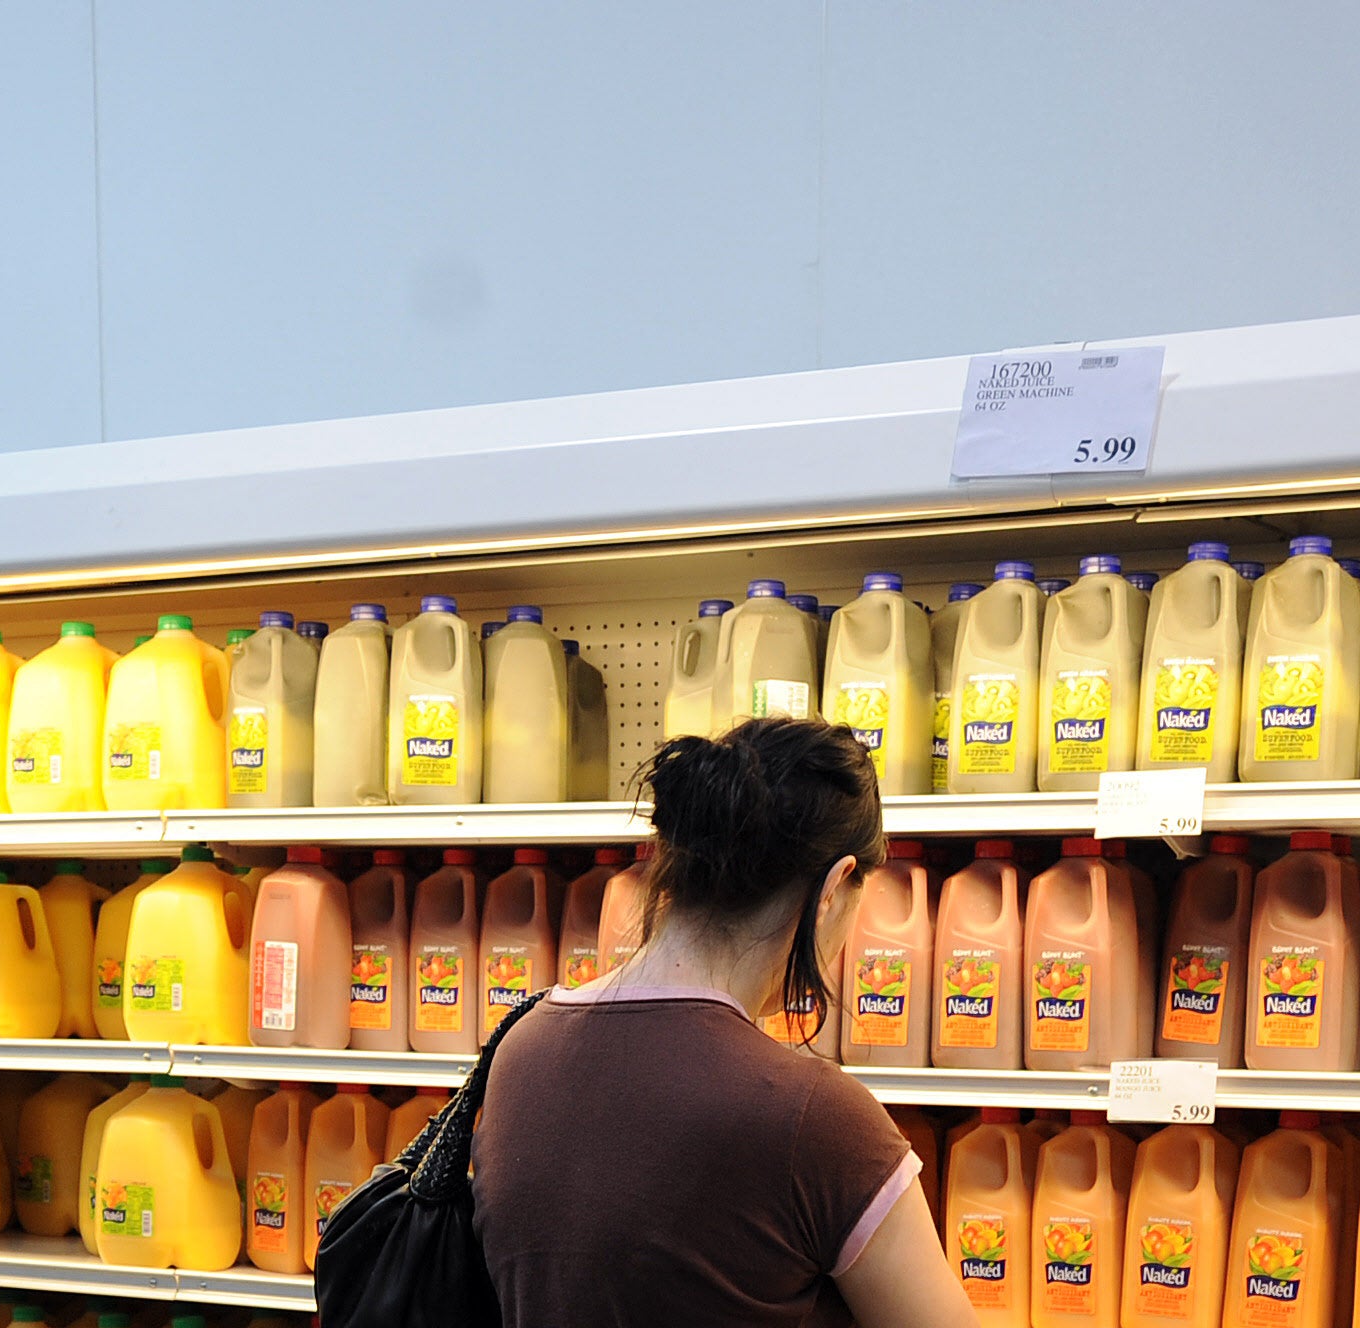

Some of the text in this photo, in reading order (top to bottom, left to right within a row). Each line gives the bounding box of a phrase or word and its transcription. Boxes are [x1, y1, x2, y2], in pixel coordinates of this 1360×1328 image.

[991, 361, 1052, 379] 167200
[979, 376, 1054, 388] NAKED JUICE
[977, 387, 1073, 400] GREEN MACHINE
[975, 402, 1006, 411] 64 OZ
[1074, 437, 1136, 463] 5.99
[1159, 710, 1205, 728] Naked
[1264, 709, 1311, 727] Naked
[966, 725, 1008, 741] Naked
[1057, 723, 1101, 739] Naked
[409, 741, 449, 756] Naked
[1159, 817, 1196, 833] 5.99
[421, 989, 455, 1004] Naked
[1174, 993, 1214, 1010] Naked
[860, 998, 900, 1014] Naked
[948, 999, 988, 1014] Naked
[1038, 1002, 1079, 1018] Naked
[1266, 997, 1311, 1014] Naked
[1120, 1066, 1152, 1076] 22201
[1171, 1105, 1210, 1120] 5.99
[964, 1262, 1001, 1278] Naked
[1048, 1266, 1087, 1281] Naked
[1143, 1267, 1185, 1285] Naked
[1249, 1279, 1294, 1298] Naked
